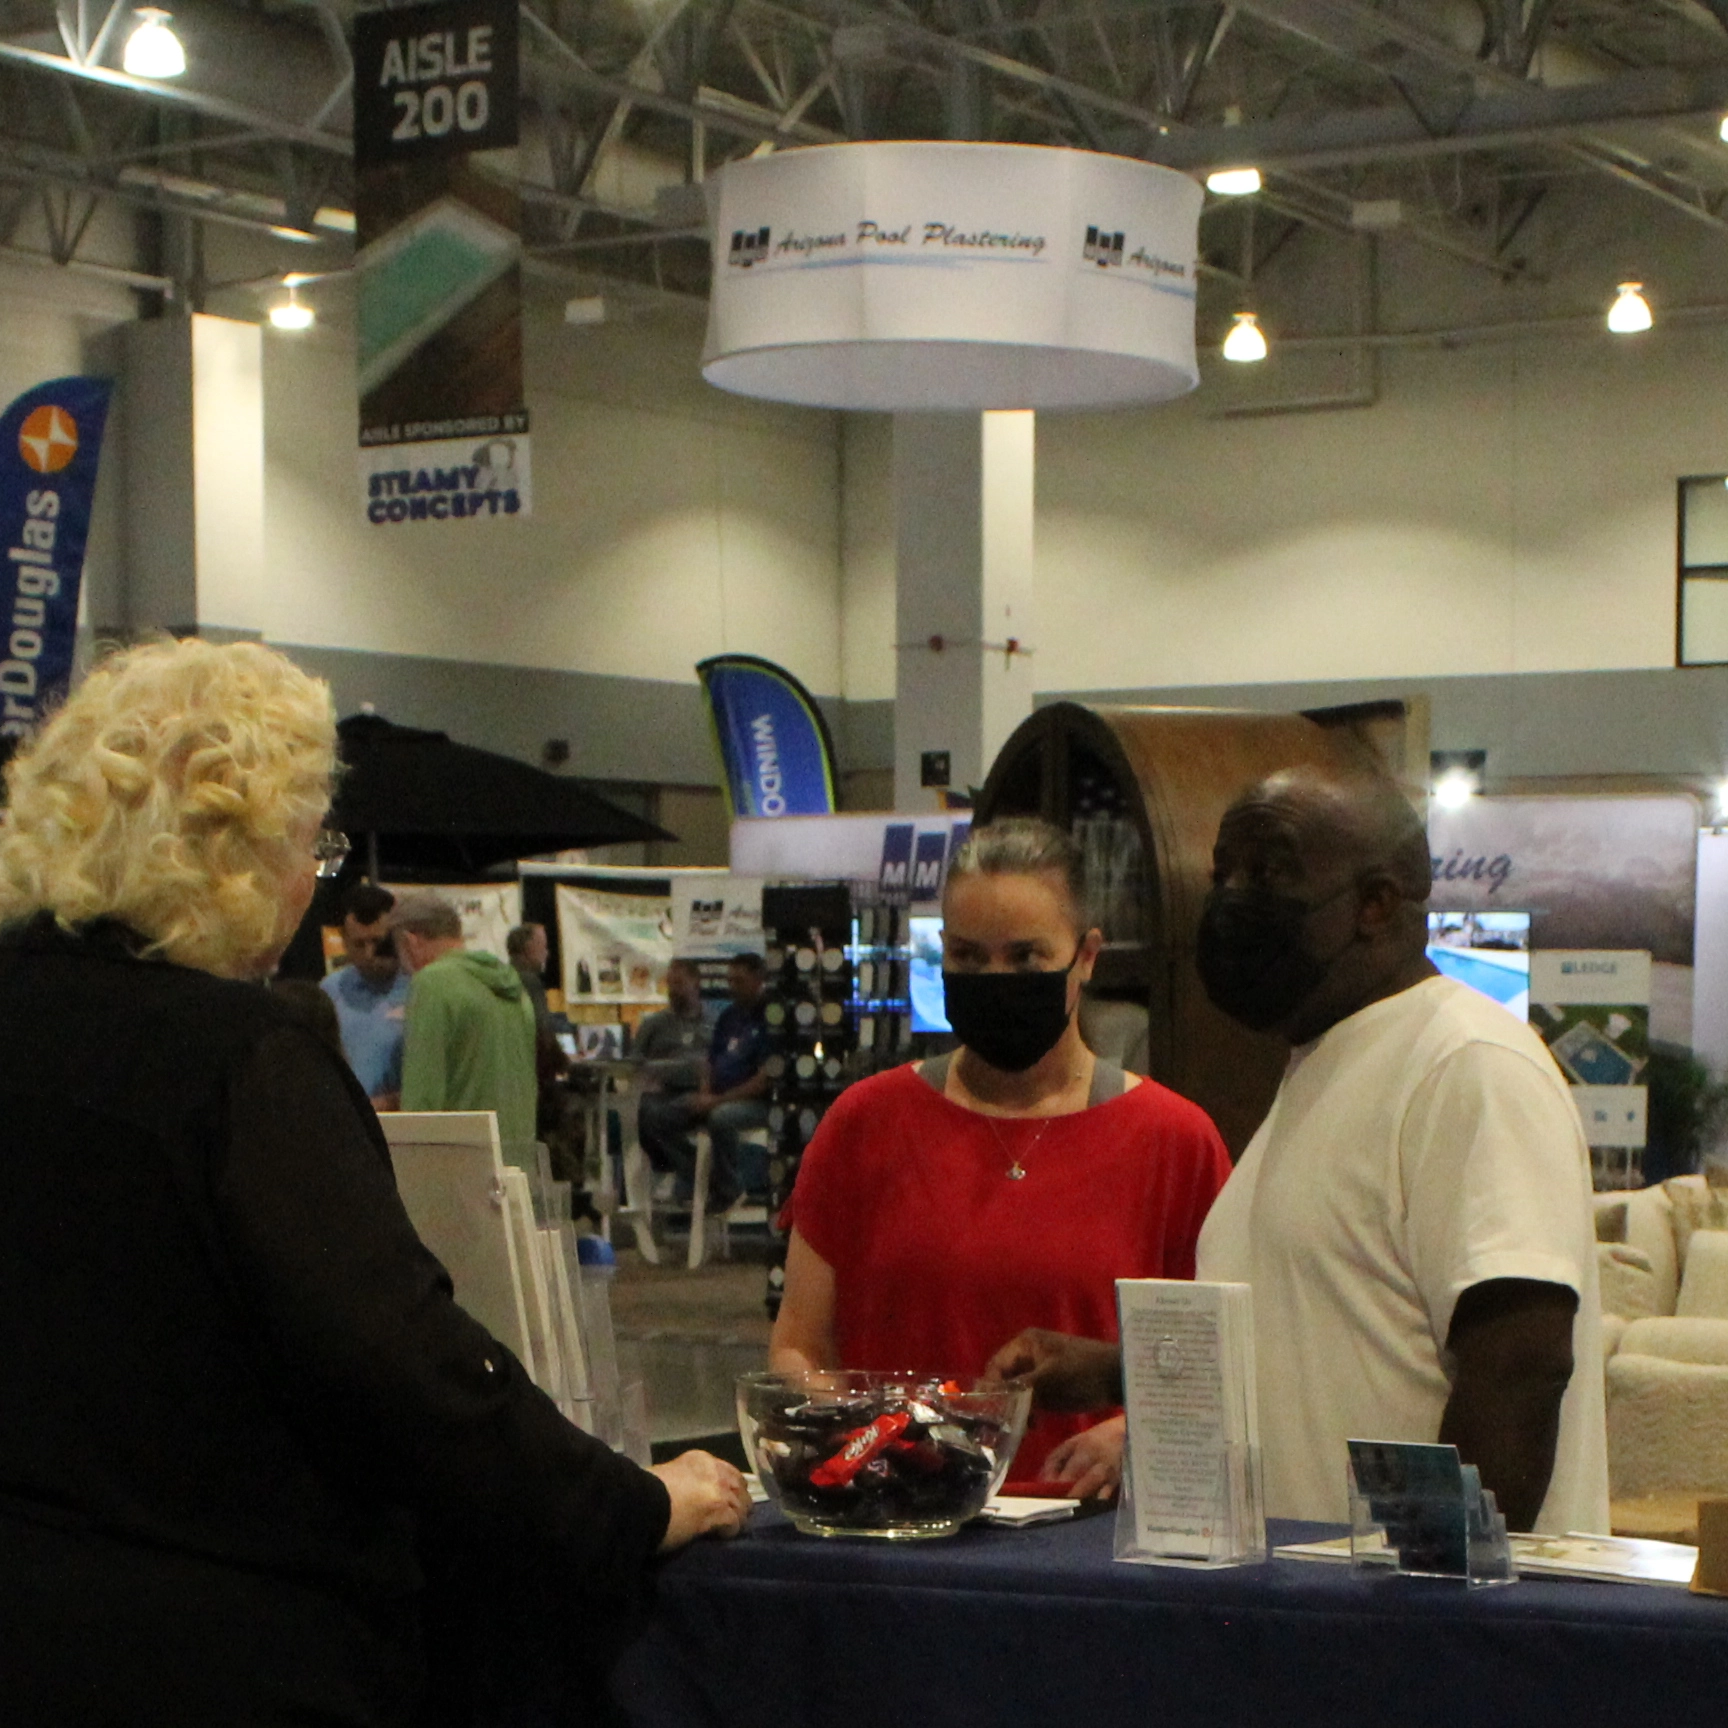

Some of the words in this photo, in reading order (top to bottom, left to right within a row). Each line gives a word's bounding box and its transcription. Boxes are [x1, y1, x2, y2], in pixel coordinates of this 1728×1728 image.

[379, 24, 494, 88] AISLE
[390, 80, 490, 141] 200
[775, 231, 846, 256] Arizona
[856, 219, 911, 245] Pool
[922, 220, 1046, 256] Plastering
[368, 463, 481, 497] STEAMY
[367, 488, 521, 524] CONCEPTS
